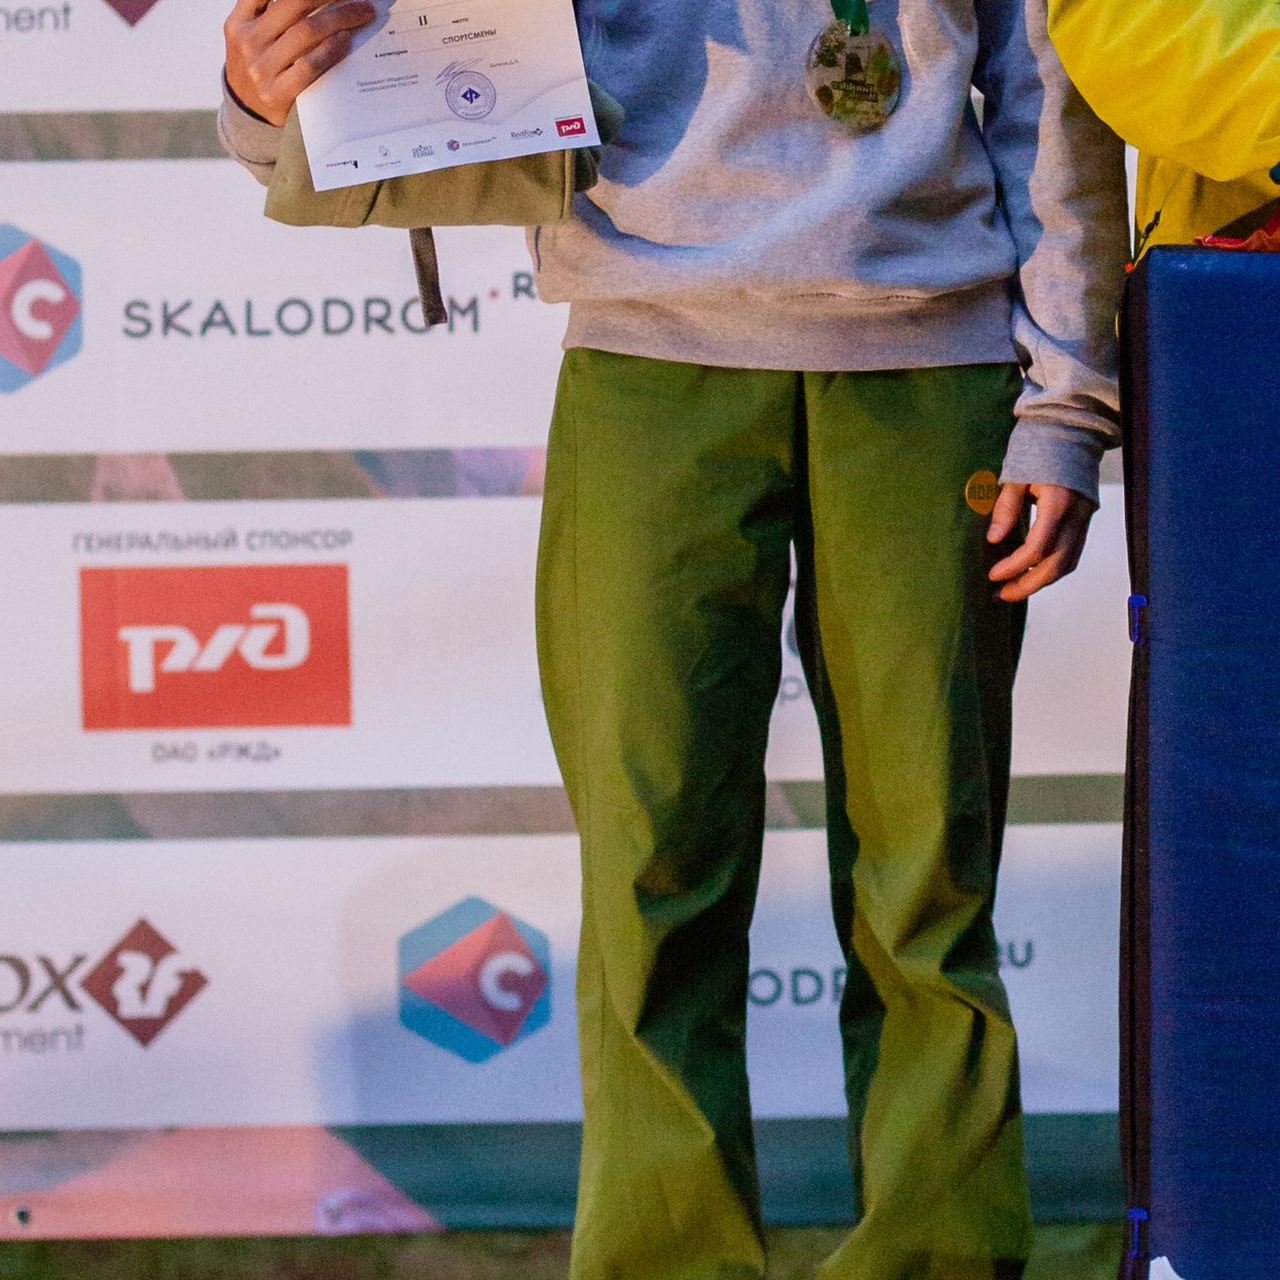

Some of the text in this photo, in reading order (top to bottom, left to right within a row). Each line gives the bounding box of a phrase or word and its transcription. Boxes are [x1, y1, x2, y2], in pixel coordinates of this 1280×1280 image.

[441, 28, 498, 45] СПОРТСМЕНЫ
[72, 528, 353, 555] ГЕНЕРАЛЬНЫЙ СПОНСОР
